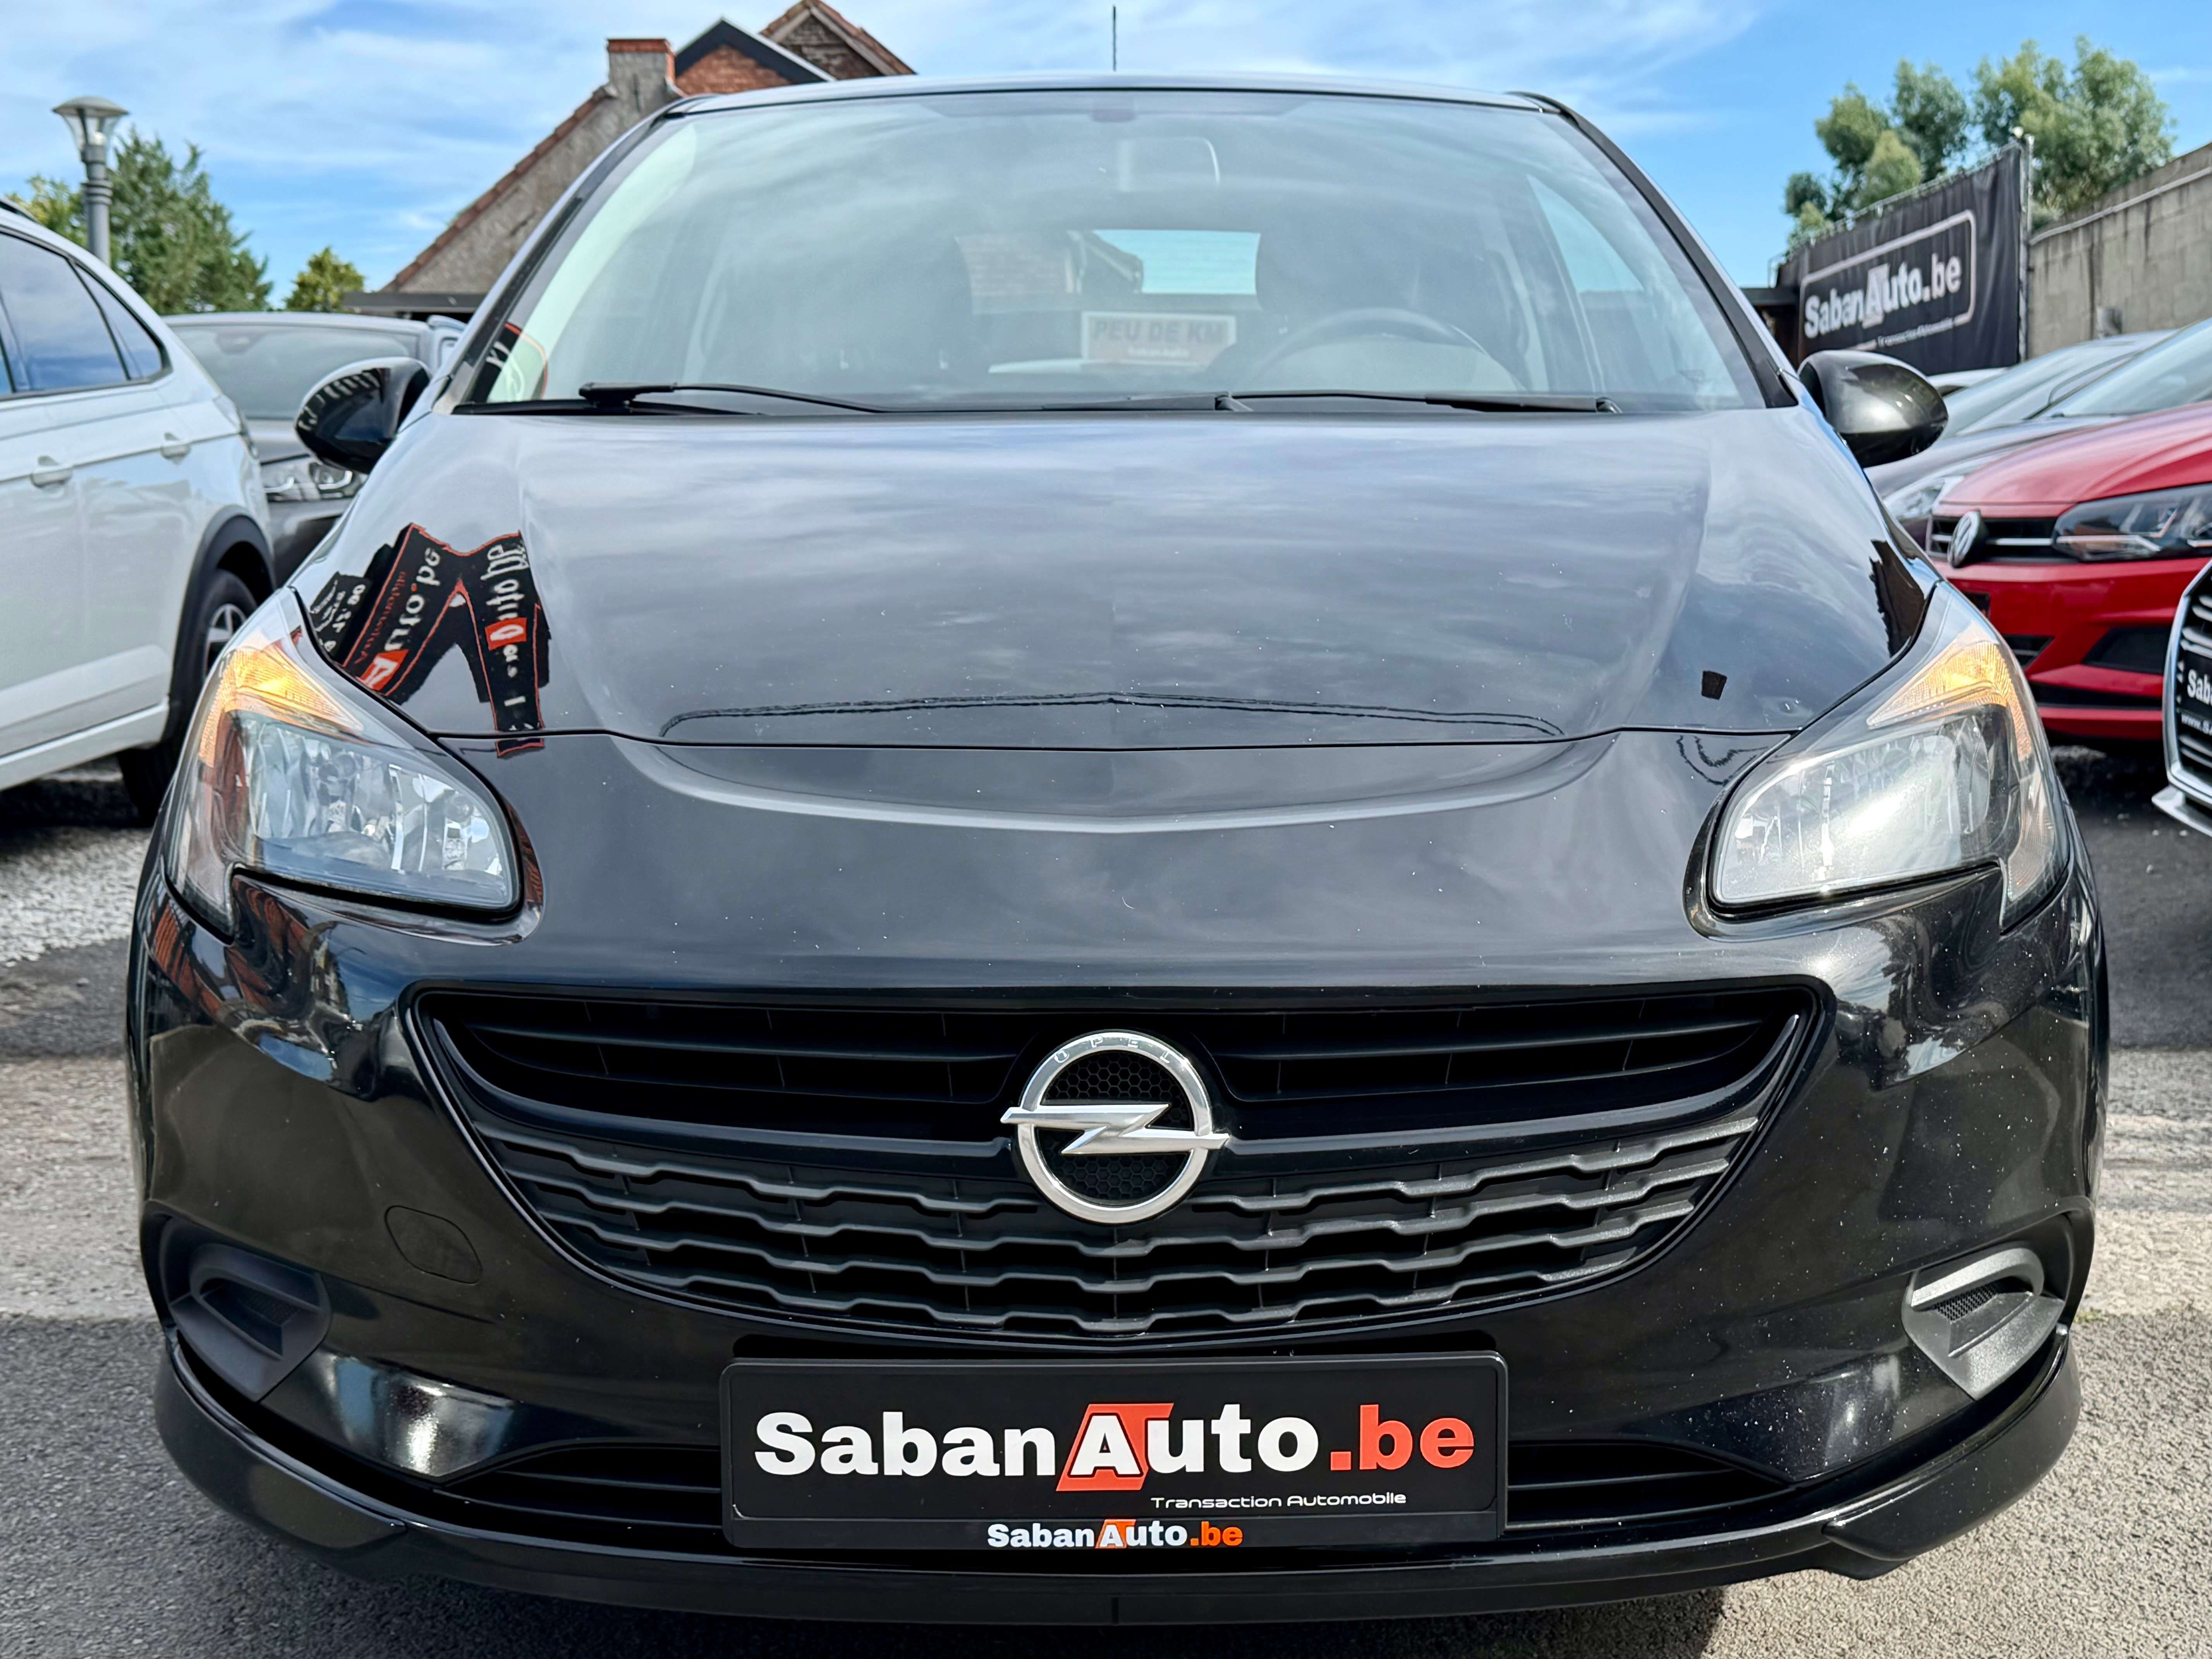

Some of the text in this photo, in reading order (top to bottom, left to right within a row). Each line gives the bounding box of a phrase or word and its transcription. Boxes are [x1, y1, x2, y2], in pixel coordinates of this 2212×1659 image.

[1805, 253, 1961, 338] SabanAuto.be
[1093, 320, 1139, 341] PEU
[1148, 321, 1180, 343] DE
[2187, 669, 2212, 706] Sab
[1054, 1035, 1171, 1063] OPEL
[755, 1403, 1474, 1477] SabanAuto.be
[1151, 1492, 1407, 1508] Transaction Automobile
[988, 1519, 1242, 1548] SabanAuto.be
